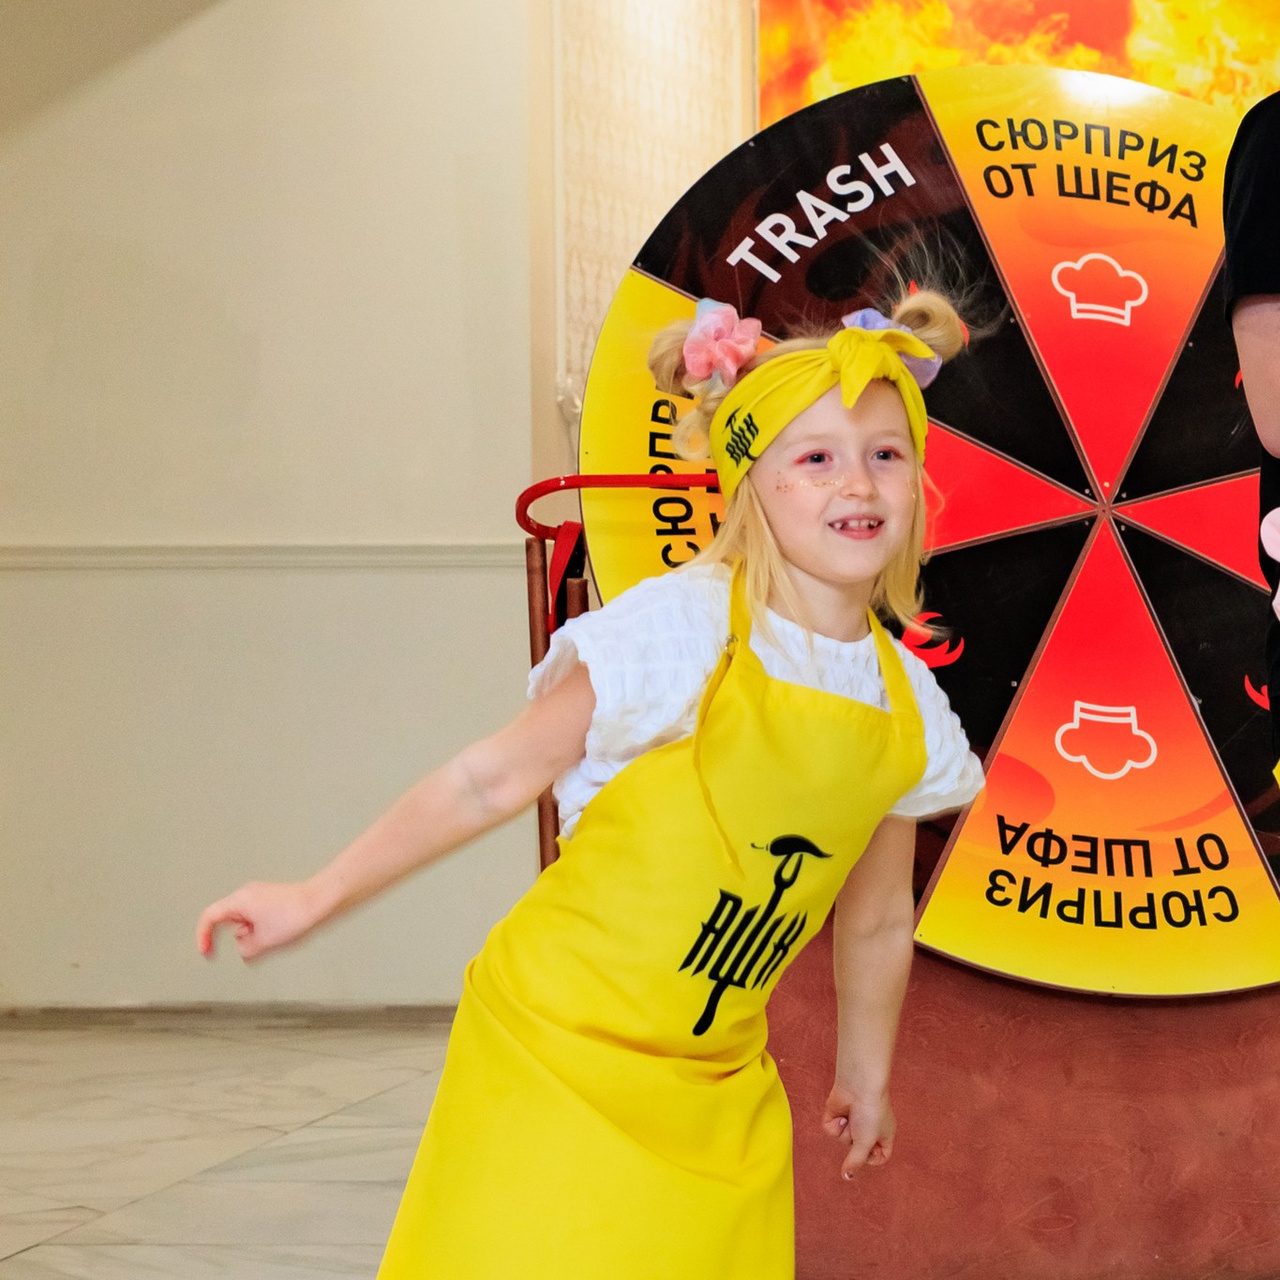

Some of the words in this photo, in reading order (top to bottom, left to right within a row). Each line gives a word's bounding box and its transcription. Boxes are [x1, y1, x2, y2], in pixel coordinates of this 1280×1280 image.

[975, 118, 1207, 182] СЮРПРИЗ
[726, 142, 916, 283] TRASH
[983, 163, 1037, 199] ОТ
[1056, 164, 1198, 229] ШЕФА
[996, 814, 1153, 878] ШЕФА
[1173, 833, 1229, 877] ОТ
[985, 869, 1239, 930] СЮРПРИЗ
